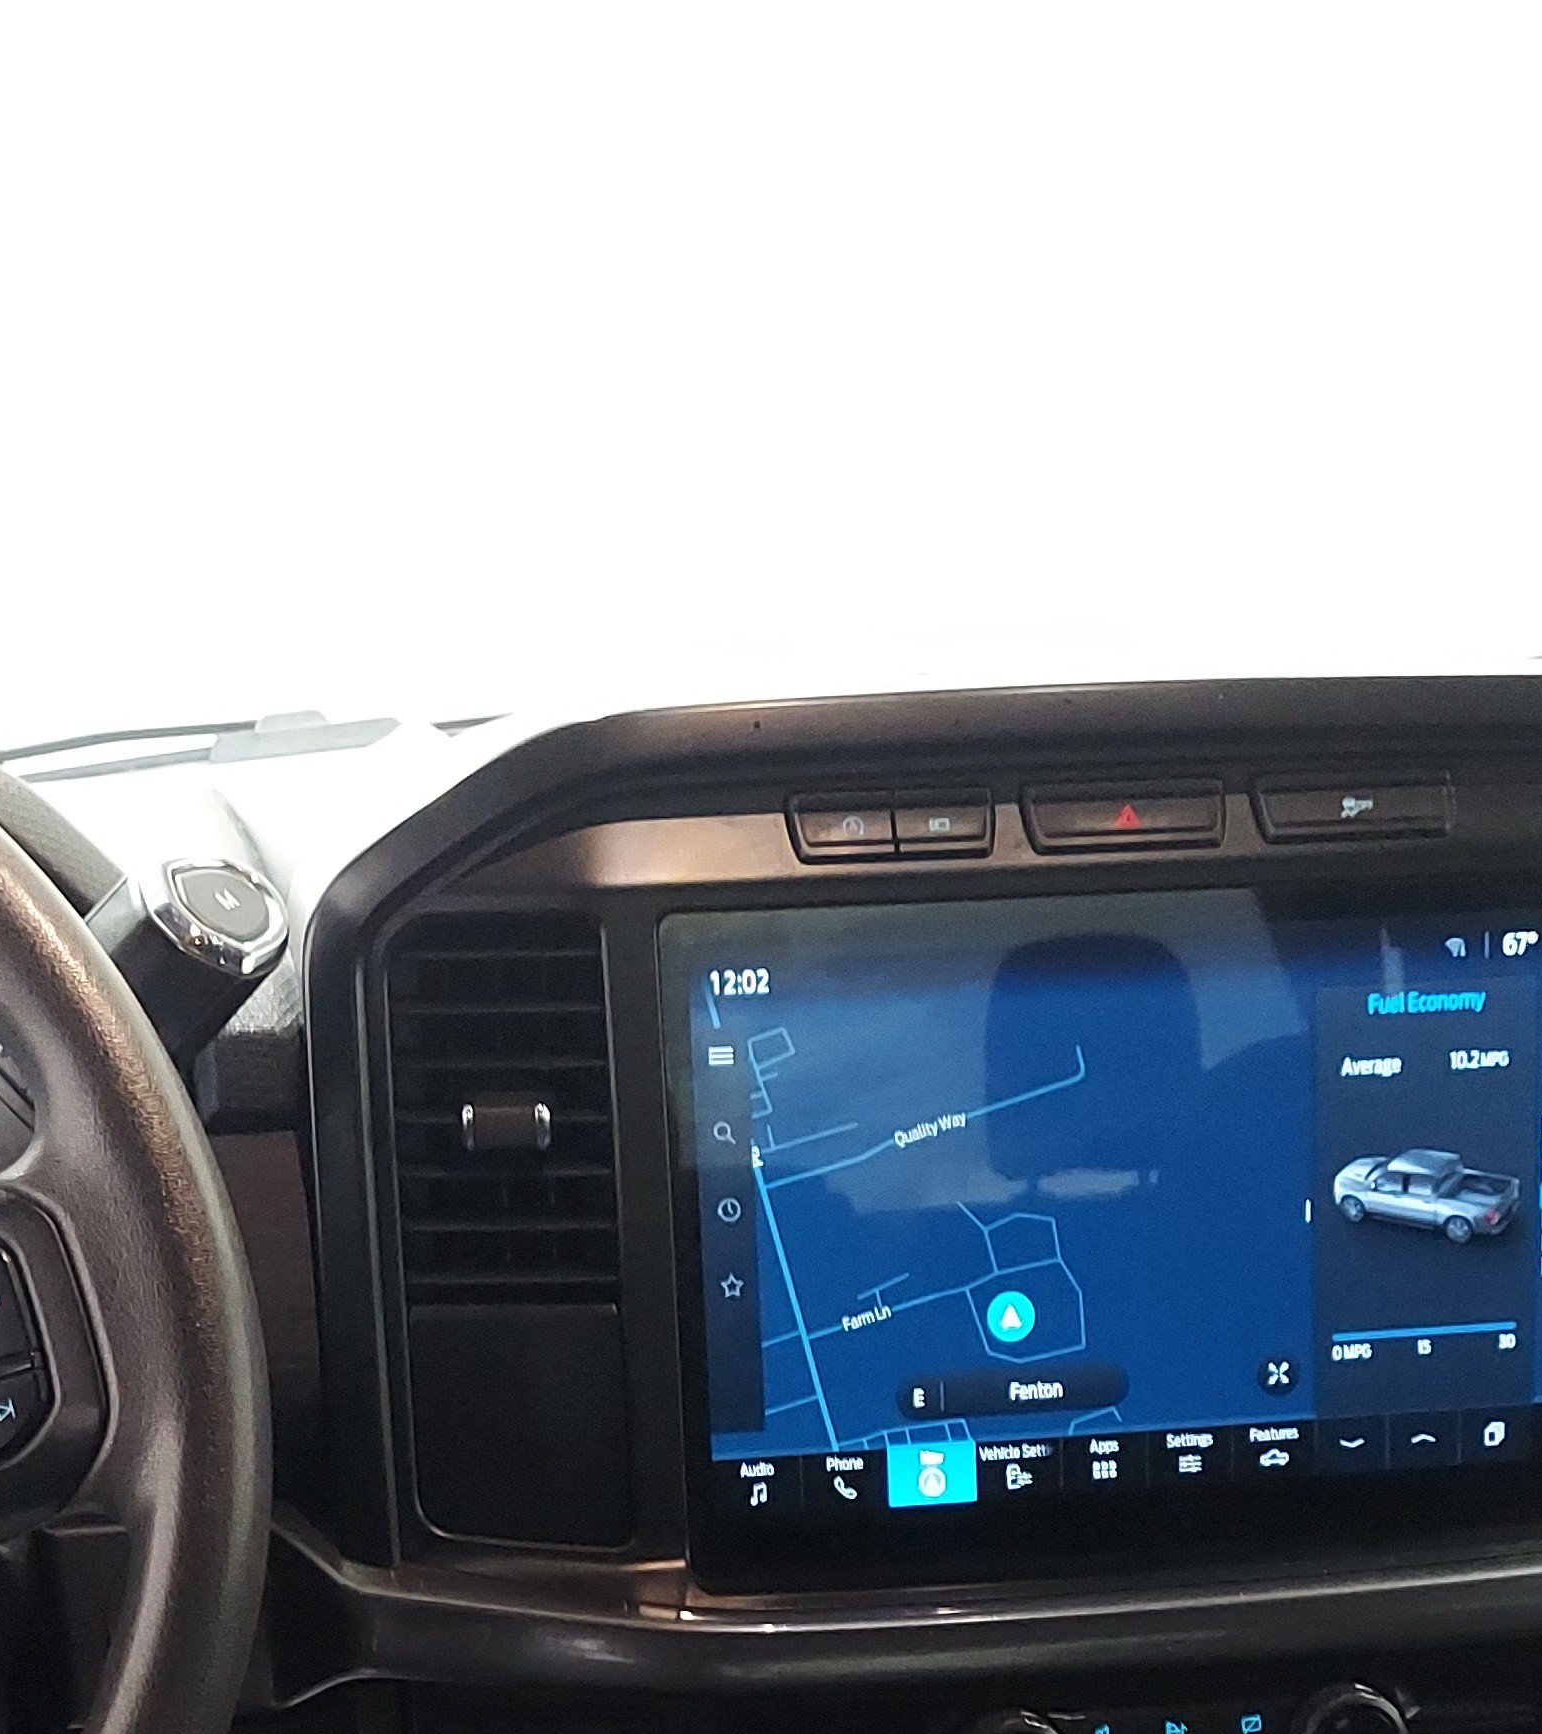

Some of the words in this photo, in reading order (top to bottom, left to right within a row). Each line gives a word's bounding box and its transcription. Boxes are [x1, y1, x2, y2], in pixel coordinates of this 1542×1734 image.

[1502, 930, 1539, 957] 67°
[709, 967, 770, 996] 12:02
[1367, 992, 1405, 1015] Fuel
[1407, 991, 1486, 1013] Economy
[1340, 1056, 1402, 1078] Average
[1449, 1050, 1479, 1070] 10.2
[894, 1120, 938, 1149] Quality
[937, 1112, 966, 1132] Way
[842, 1312, 875, 1332] Farm
[875, 1303, 892, 1321] Ln
[1343, 1343, 1372, 1360] MPG
[1010, 1380, 1063, 1401] Fenton
[1166, 1432, 1214, 1449] Settings
[1249, 1426, 1299, 1442] Features
[979, 1443, 1020, 1461] Vehicle
[1090, 1438, 1119, 1455] Apps
[740, 1461, 774, 1478] Audio
[826, 1455, 864, 1472] Phone
